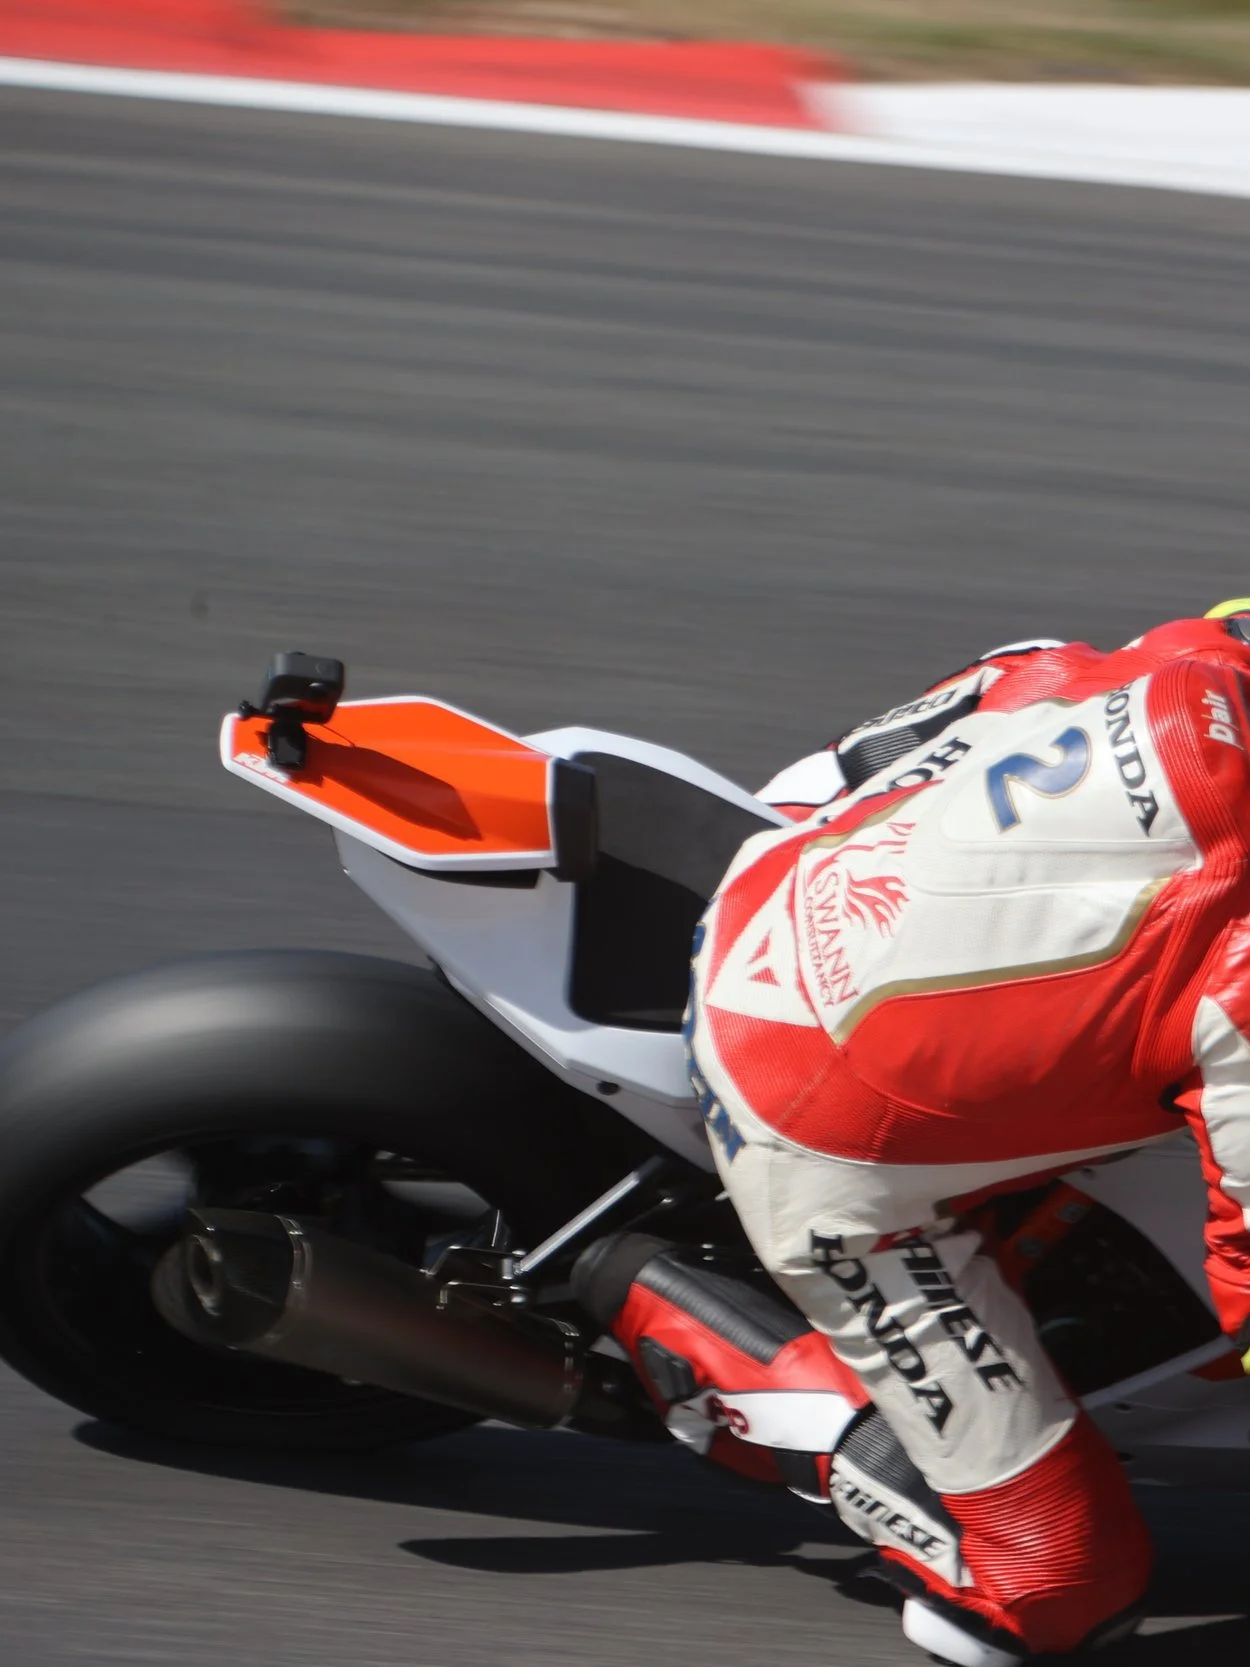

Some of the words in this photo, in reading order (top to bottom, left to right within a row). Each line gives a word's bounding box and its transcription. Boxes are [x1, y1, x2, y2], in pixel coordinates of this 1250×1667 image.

[986, 726, 1092, 834] 2
[815, 872, 859, 1004] SWANN
[809, 1229, 954, 1438] HONDA
